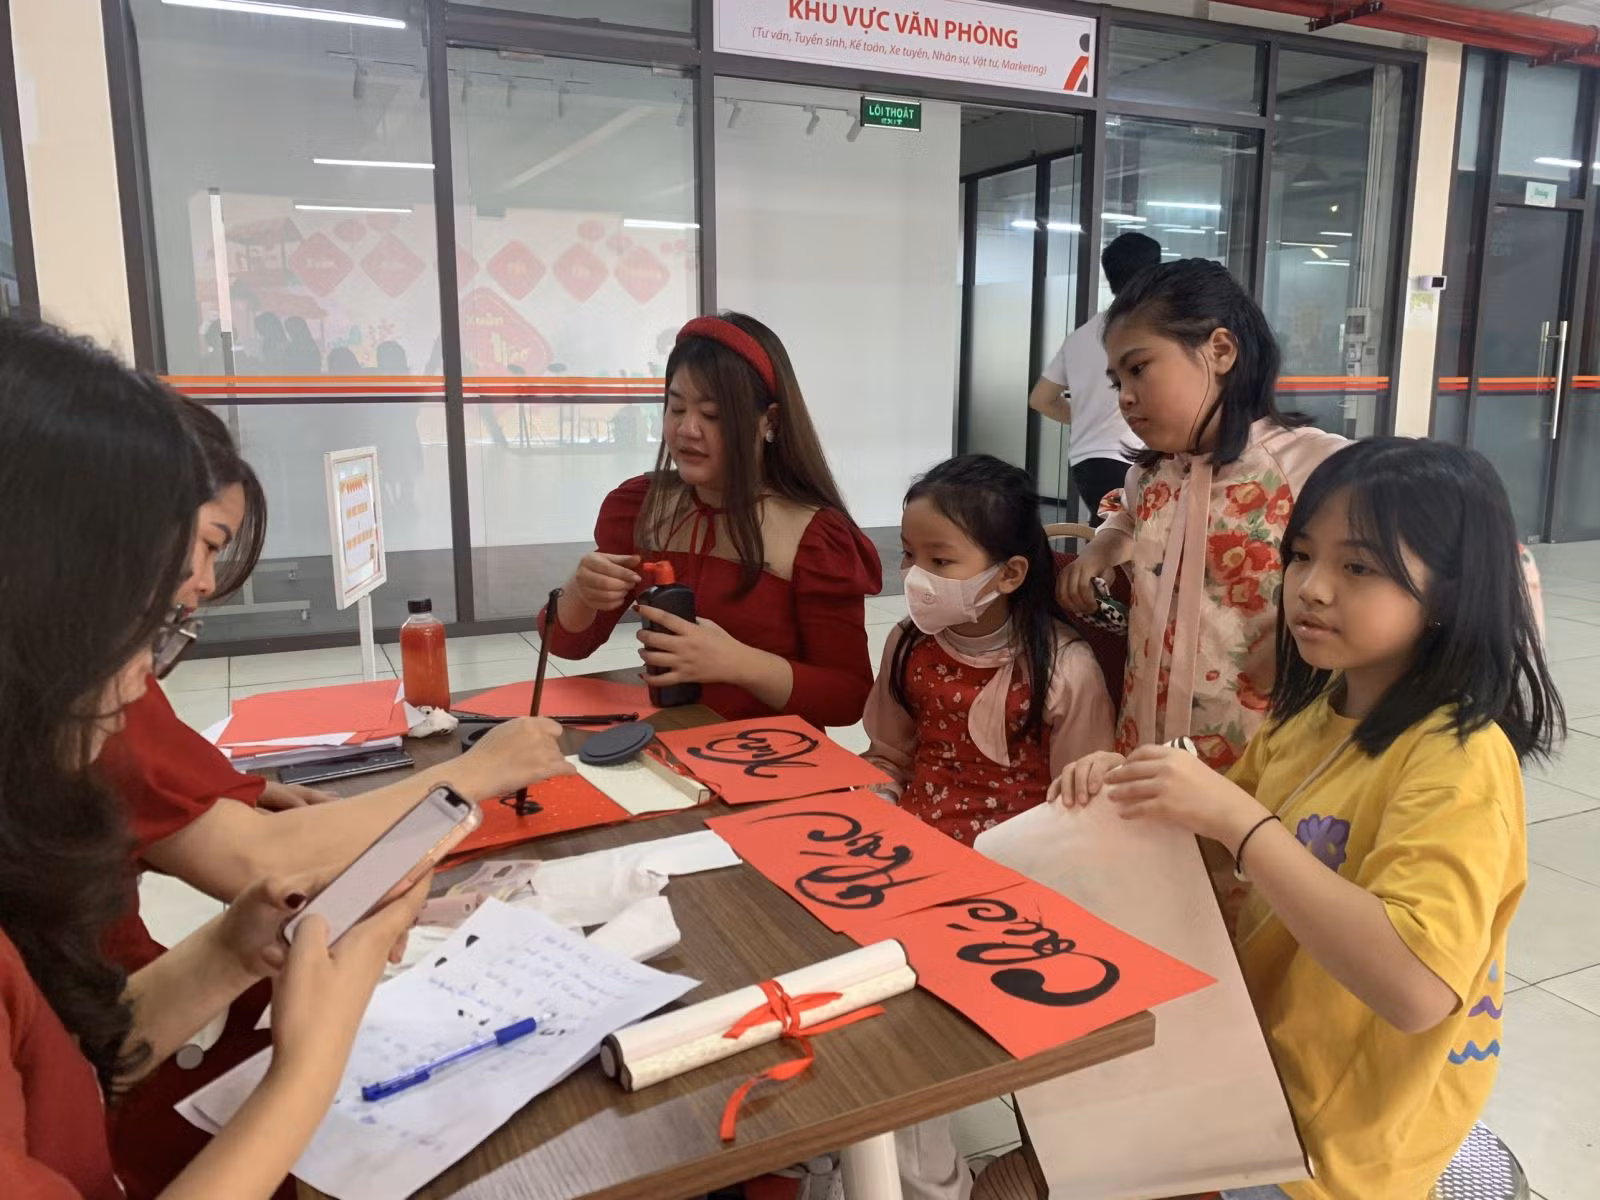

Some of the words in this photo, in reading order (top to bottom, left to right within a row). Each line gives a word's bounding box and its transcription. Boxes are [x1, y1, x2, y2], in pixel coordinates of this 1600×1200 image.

[788, 0, 838, 24] KHU
[843, 5, 891, 35] VỰC
[894, 11, 939, 38] VĂN
[944, 20, 1018, 49] PHÒNG
[824, 37, 848, 50] sinh,
[849, 40, 862, 51] Kế
[863, 41, 888, 55] toán,
[889, 44, 900, 56] Xe
[931, 49, 957, 64] Nhân
[973, 55, 988, 67] Vật
[1001, 59, 1048, 77] Marketing)
[881, 117, 903, 126] EXIT
[885, 106, 914, 120] THOÁT
[945, 898, 1121, 1007] Chúc
